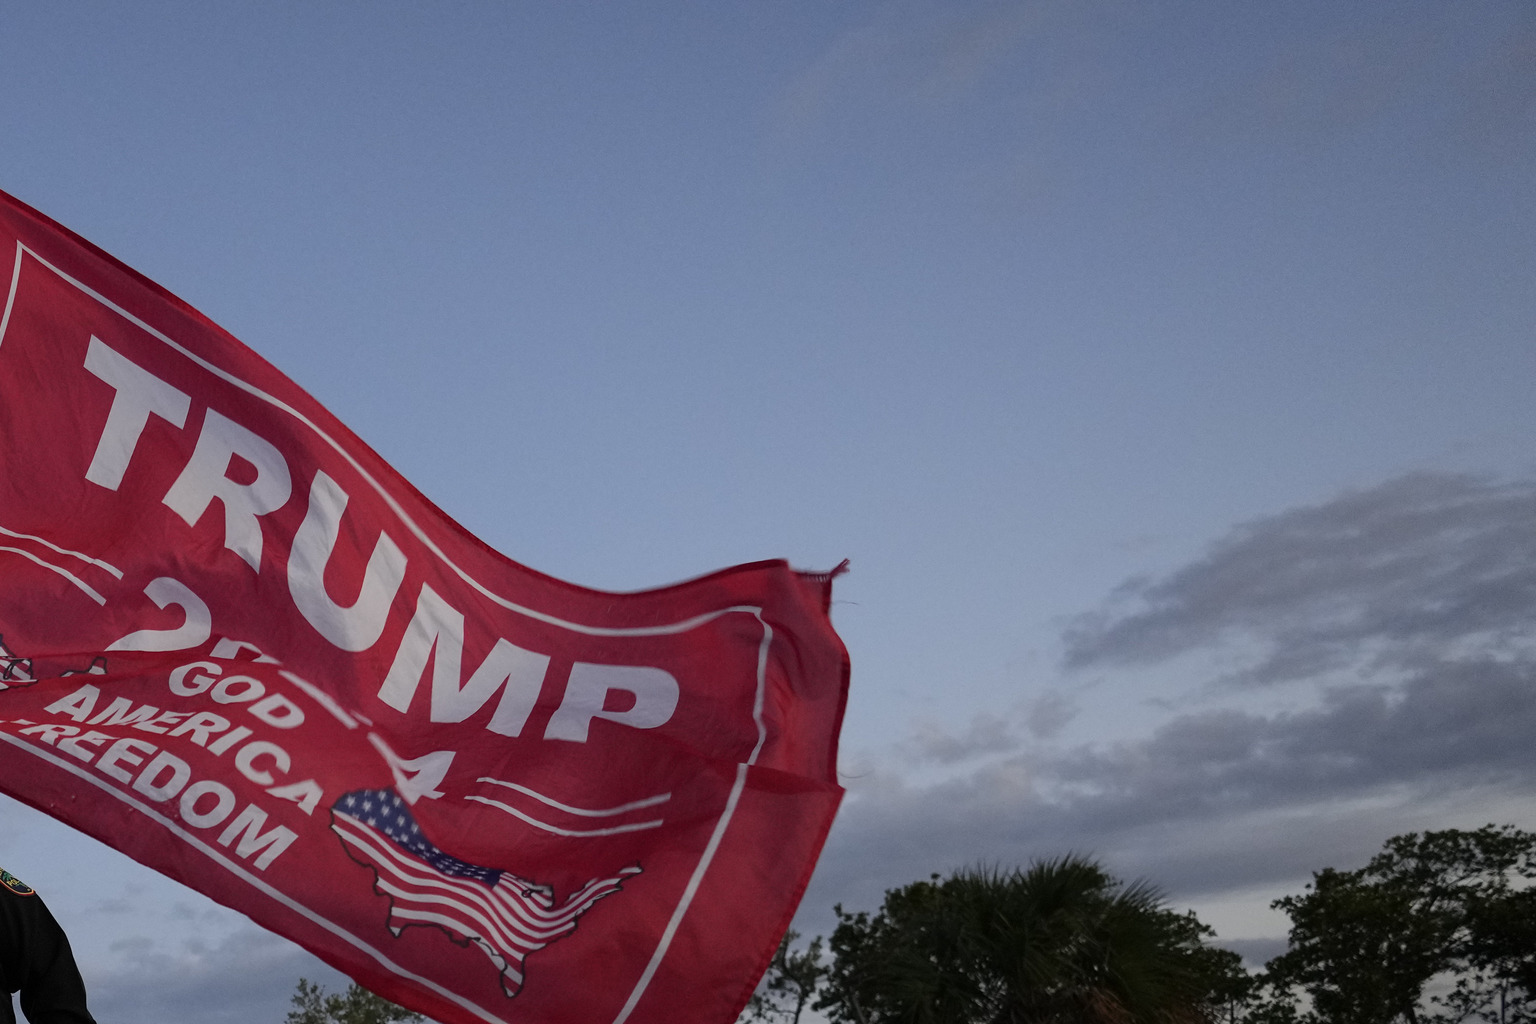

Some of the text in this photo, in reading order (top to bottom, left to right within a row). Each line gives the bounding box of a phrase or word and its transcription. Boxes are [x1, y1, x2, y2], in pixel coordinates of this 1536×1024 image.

[83, 334, 679, 743] TRUMP
[43, 684, 324, 817] AMERICA
[169, 661, 305, 729] GOD
[10, 718, 299, 872] REEDOM
